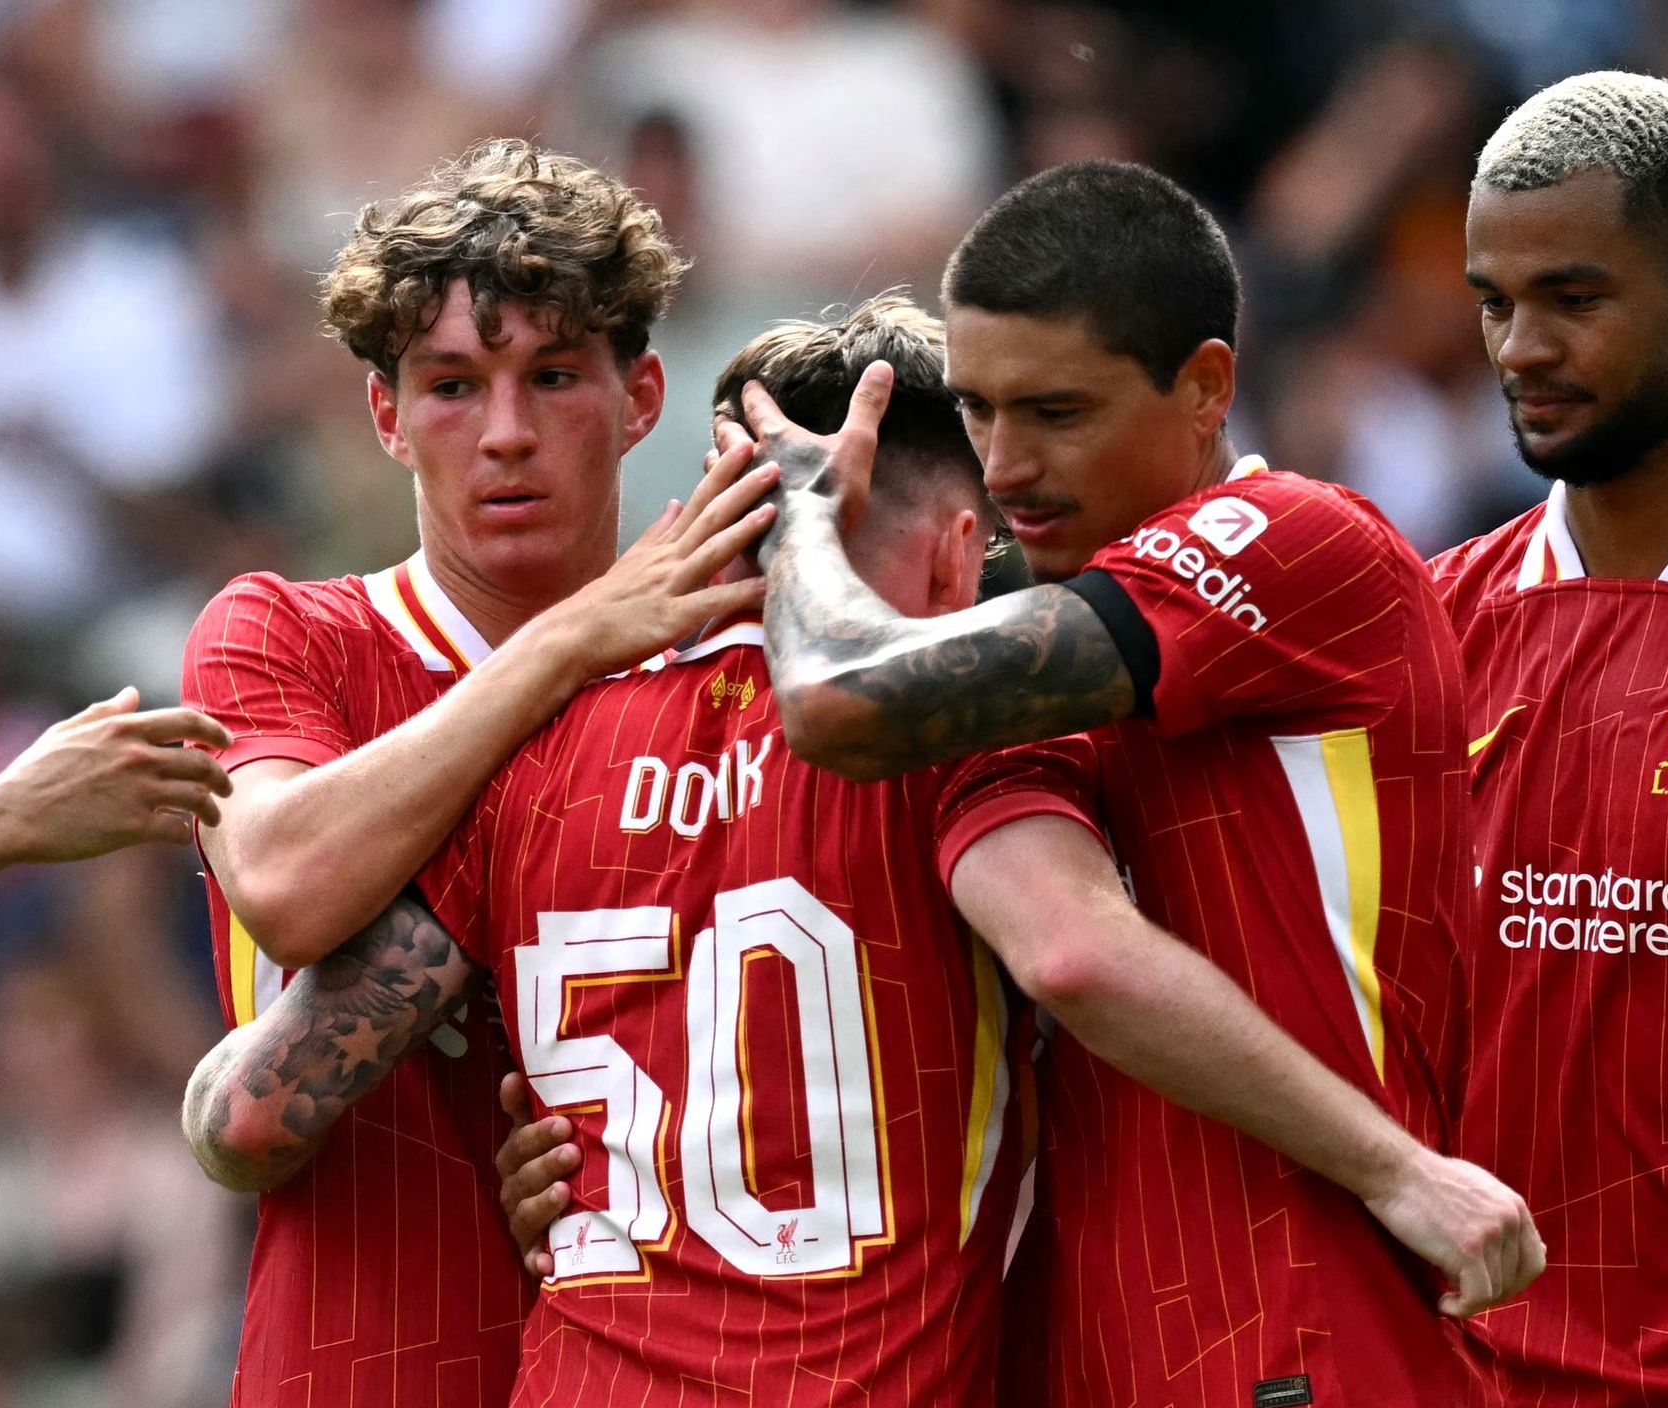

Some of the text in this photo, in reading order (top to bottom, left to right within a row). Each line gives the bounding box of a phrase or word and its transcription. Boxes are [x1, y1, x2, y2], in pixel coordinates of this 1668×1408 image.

[1120, 527, 1268, 632] xpedia
[726, 682, 744, 696] 97
[514, 875, 895, 1291] 50
